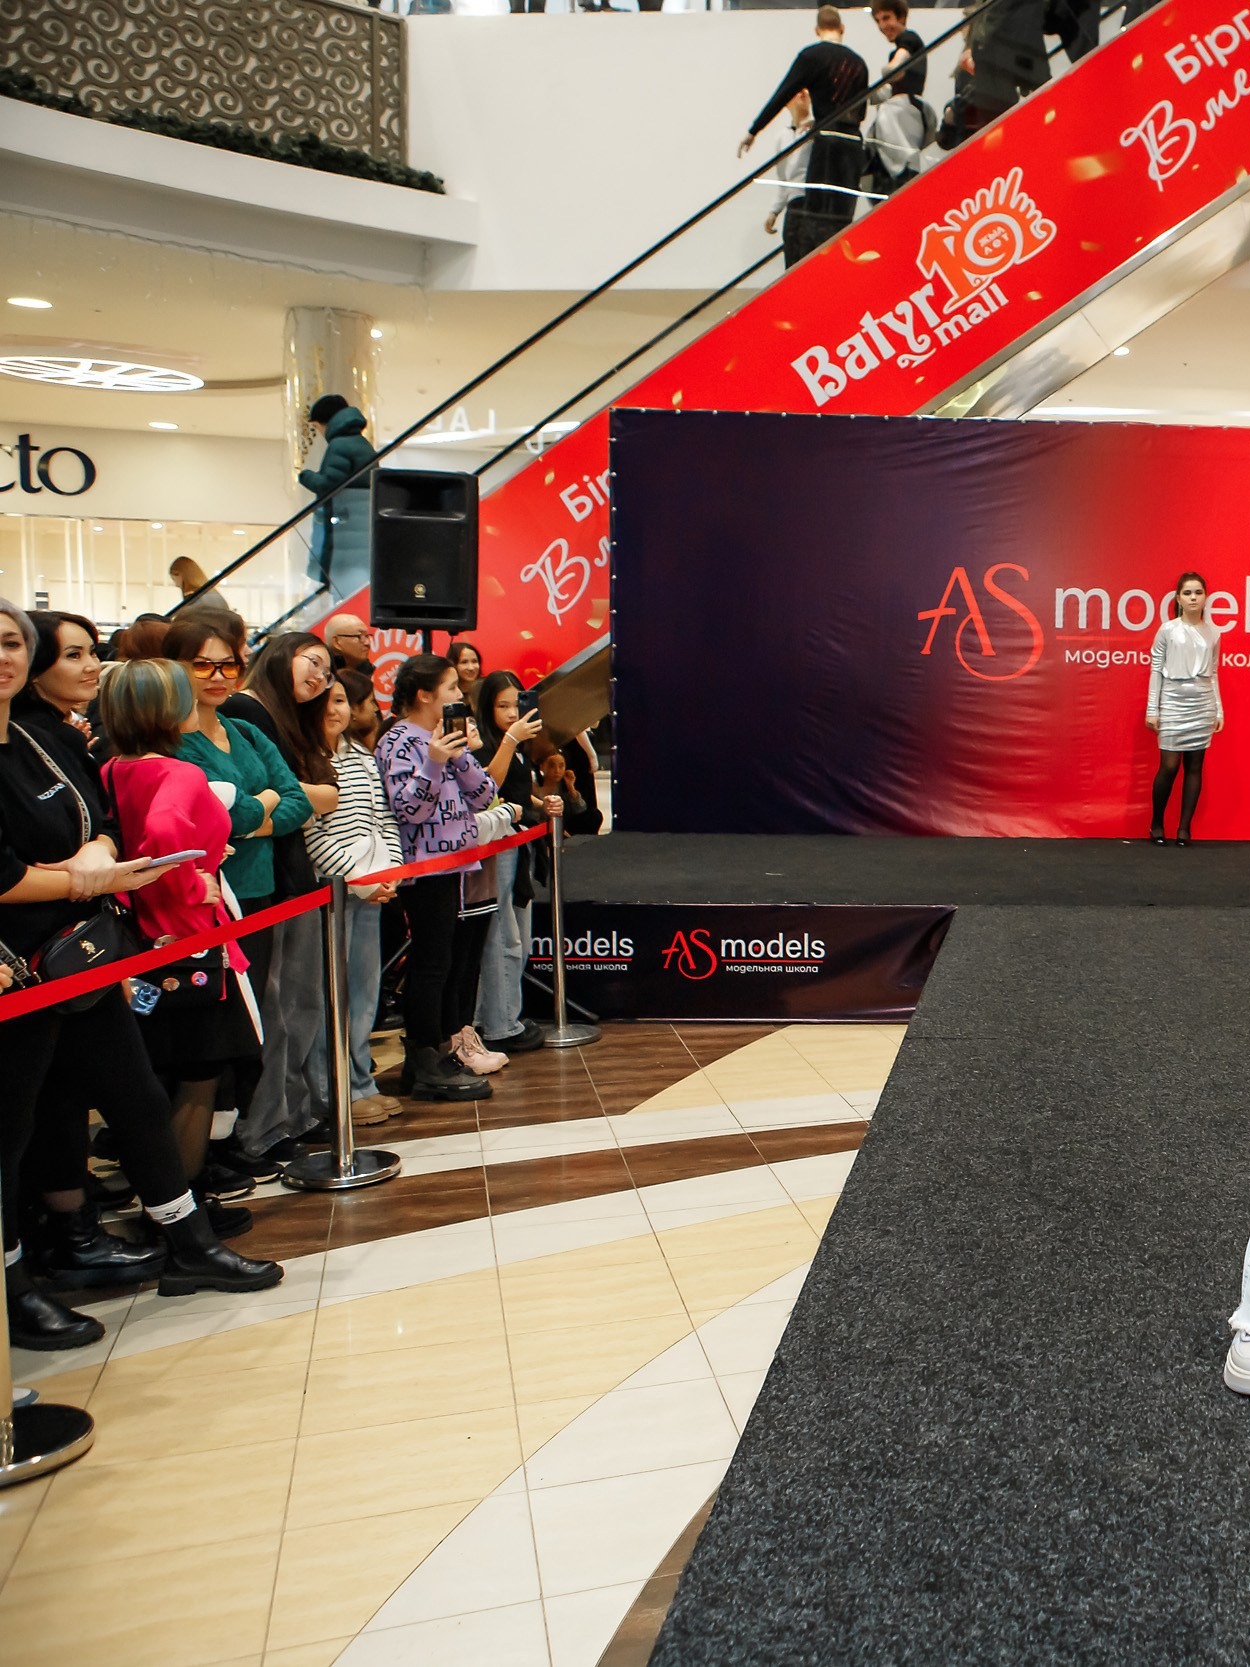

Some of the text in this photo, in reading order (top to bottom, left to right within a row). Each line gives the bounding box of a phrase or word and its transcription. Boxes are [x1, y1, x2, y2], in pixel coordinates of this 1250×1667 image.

[933, 284, 1009, 347] mall
[790, 282, 941, 407] Batyr
[917, 562, 1045, 682] AS
[594, 963, 628, 971] школа
[661, 929, 826, 980] AS models
[725, 964, 819, 974] модельная школа
